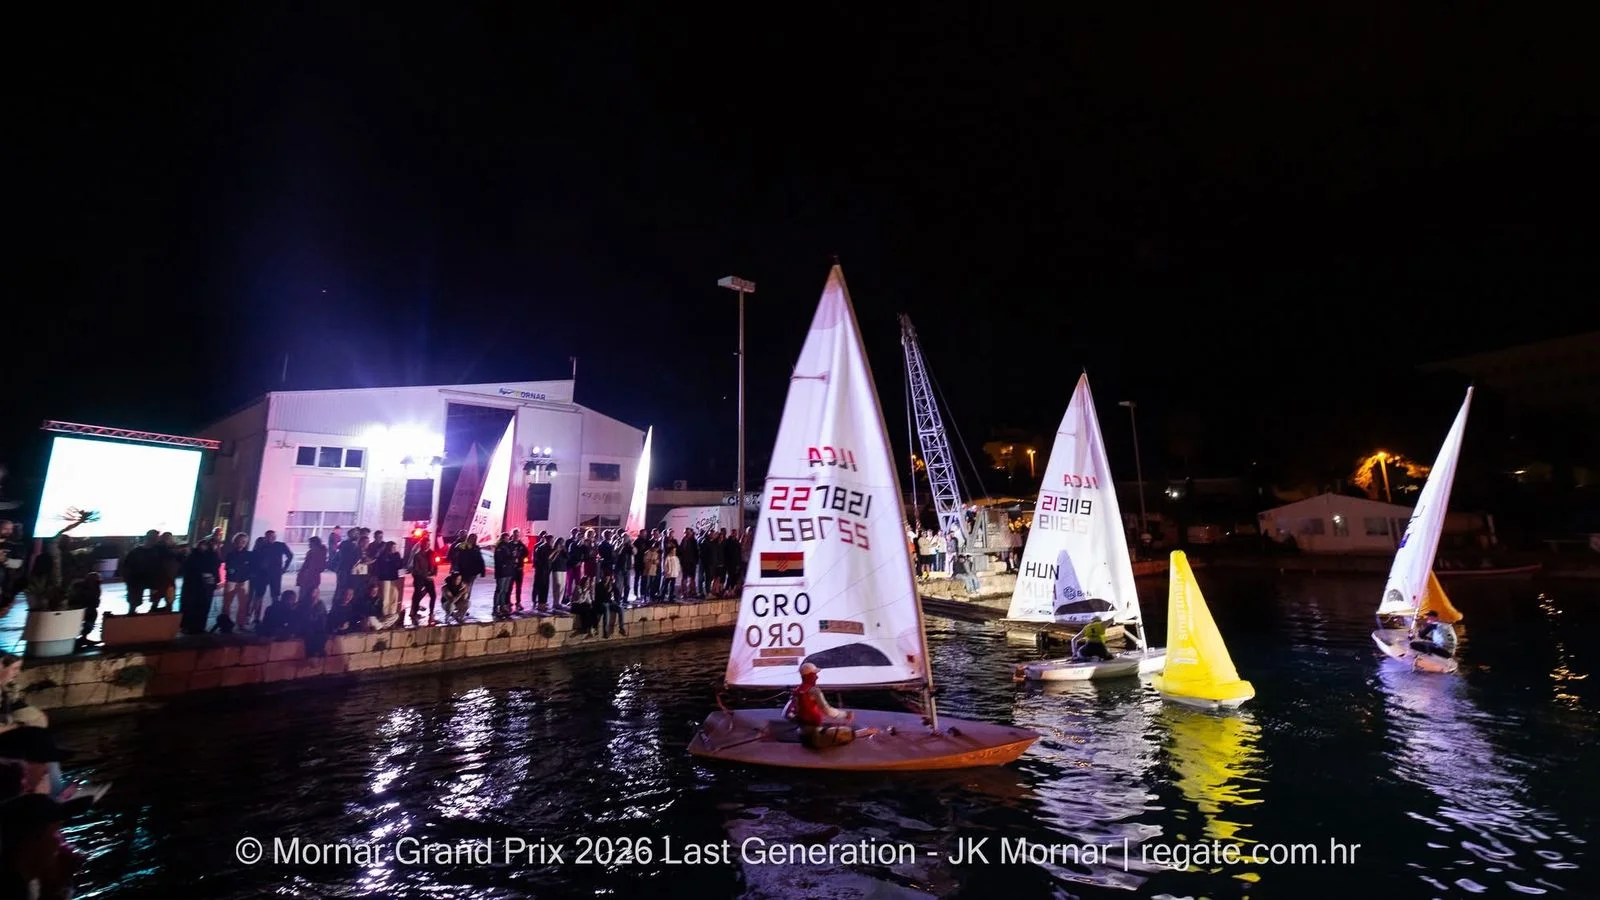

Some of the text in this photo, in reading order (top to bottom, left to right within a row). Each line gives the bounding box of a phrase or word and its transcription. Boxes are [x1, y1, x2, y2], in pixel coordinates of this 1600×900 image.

[769, 485, 872, 519] 227821
[1041, 495, 1092, 515] 213119
[1025, 561, 1060, 580] HUN
[752, 592, 811, 617] CRO
